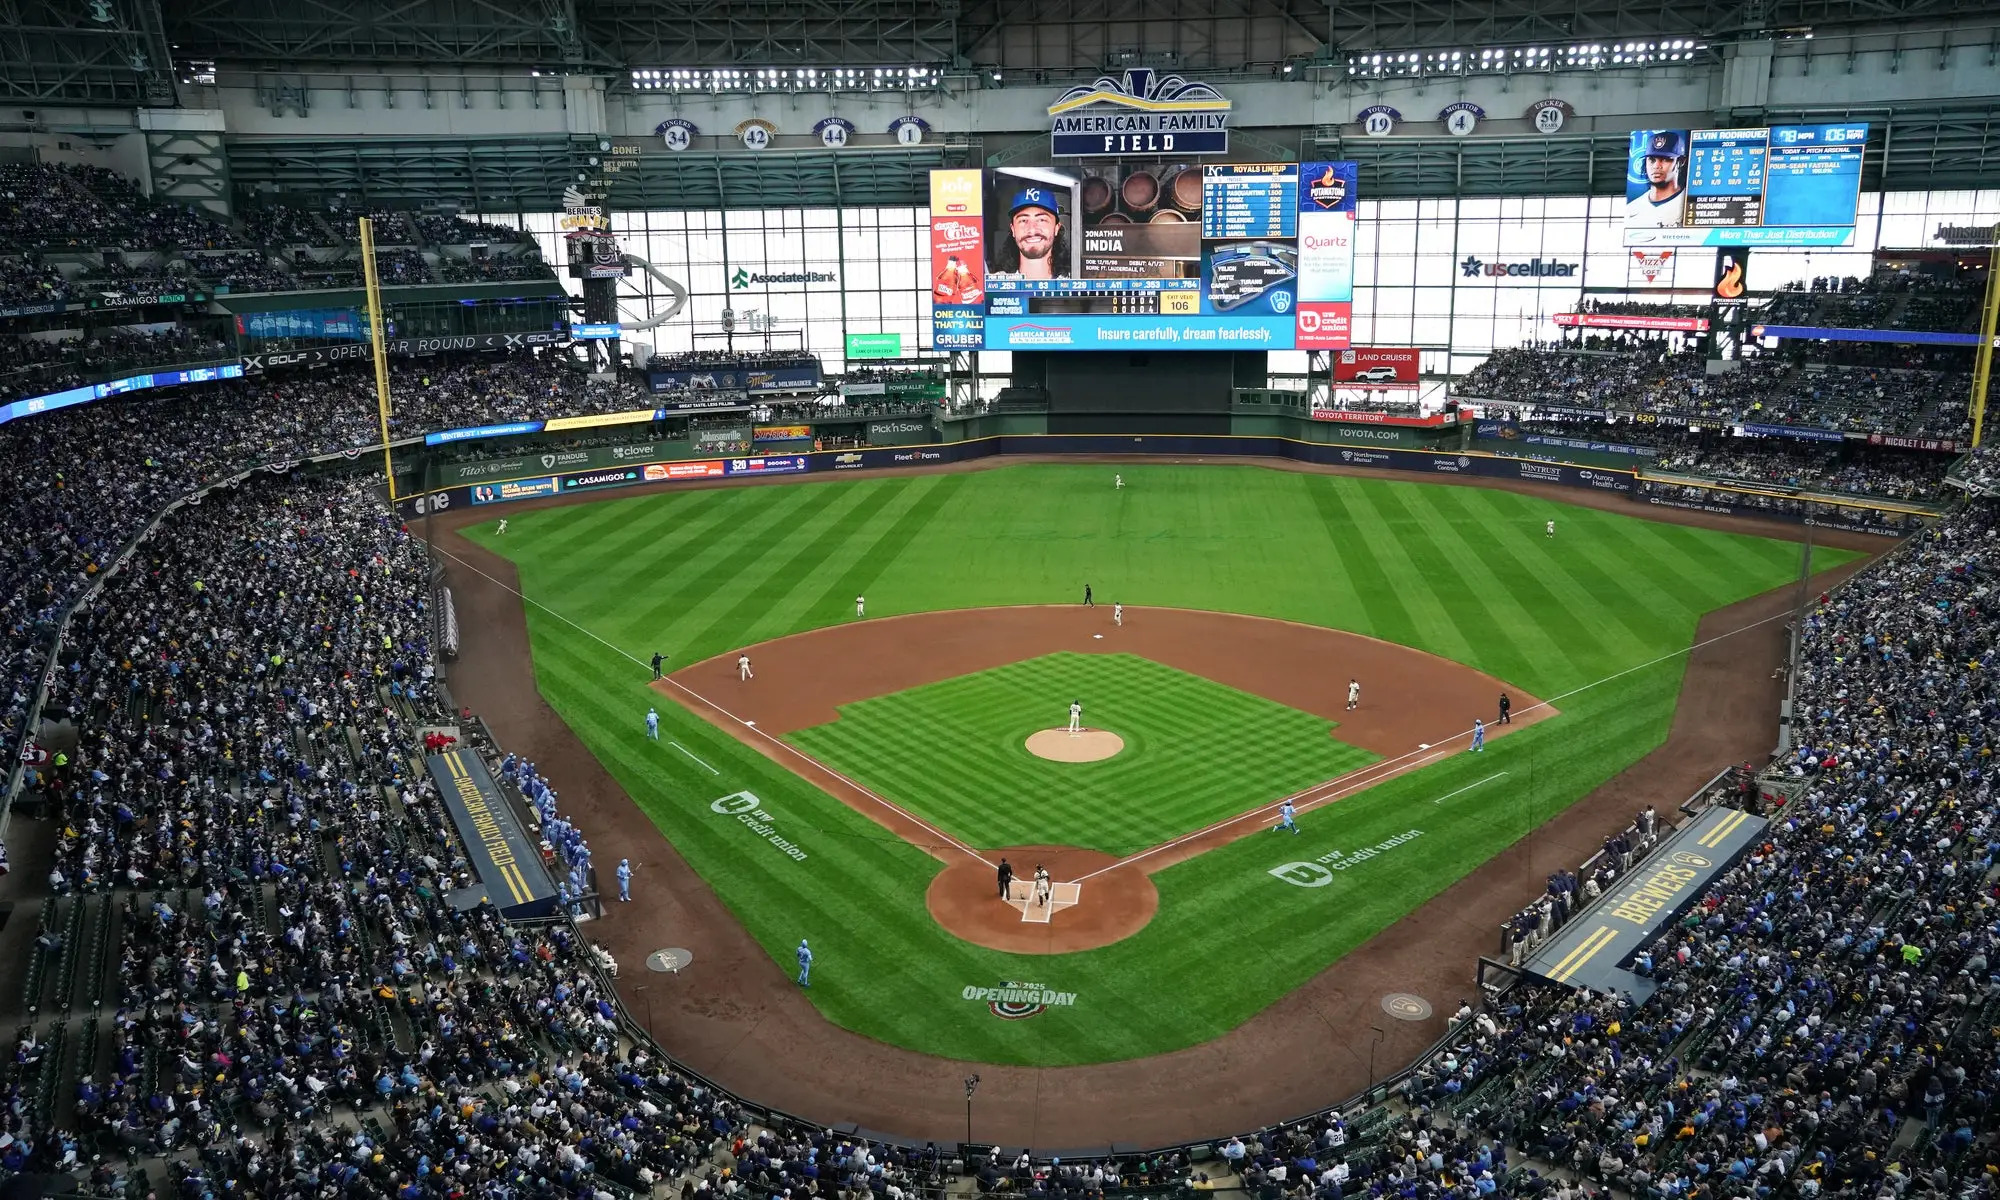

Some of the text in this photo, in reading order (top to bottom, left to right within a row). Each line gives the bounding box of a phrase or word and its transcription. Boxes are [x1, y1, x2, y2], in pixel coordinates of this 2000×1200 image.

[1367, 106, 1391, 114] YOUNT
[1445, 104, 1479, 114] MOLITOR
[1535, 99, 1564, 109] UECKER
[823, 118, 845, 126] AARON
[1455, 115, 1465, 130] 4
[1541, 110, 1558, 123] 50
[662, 118, 691, 129] FINGERS
[1054, 114, 1227, 133] AMERICAN FAMILY
[1370, 117, 1388, 132] 19
[668, 131, 687, 146] 34
[746, 131, 765, 144] 42
[825, 129, 844, 143] 44
[907, 129, 914, 142] 1
[1693, 130, 1768, 140] ELVIN RODRIGUEZ
[1797, 132, 1815, 140] MPH
[1825, 128, 1845, 141] 106
[1104, 135, 1174, 151] FIELD
[612, 146, 641, 155] GONE!
[1261, 165, 1286, 173] LINEUP
[567, 206, 601, 216] BERNIE'S
[944, 225, 980, 240] Coke
[1085, 230, 1123, 238] JONATHAN
[1720, 229, 1838, 239] More Than Just Distribution!
[1085, 240, 1123, 251] INDIA
[1304, 236, 1347, 250] Quartz
[1485, 258, 1579, 276] uscellular
[104, 296, 158, 306] CASAMIGOS
[1171, 302, 1189, 310] 106
[934, 321, 964, 329] THAT'S
[936, 334, 982, 345] GRUBER
[1097, 326, 1272, 342] Insure carefully, dream fearlessly.
[244, 355, 264, 369] X
[269, 353, 307, 366] GOLF
[330, 345, 368, 360] OPEN
[419, 337, 476, 350] ROUND
[505, 334, 523, 346] X
[527, 333, 566, 343] GOLF
[1315, 410, 1385, 421] TOYOTA TERRITORY
[1636, 413, 1687, 425] 620 WTMJ
[872, 424, 890, 433] Pick
[900, 423, 923, 432] Save
[1339, 428, 1399, 440] TOYOTA.COM
[1744, 424, 1842, 440] WINTRUST WISCONSIN'S BANK
[441, 430, 475, 440] WINTRUST
[700, 430, 741, 442] Johnsonville
[1543, 438, 1562, 446] WELCOME
[1608, 445, 1629, 453] WELCOME
[1884, 437, 1918, 448] NICOLET
[1920, 440, 1938, 450] LAW
[624, 446, 654, 455] clover
[1353, 452, 1389, 460] Northwestern
[557, 453, 588, 465] FANDUEL
[460, 466, 486, 477] Tito's
[732, 460, 746, 471] $20
[1520, 463, 1561, 475] WINTRUST
[579, 473, 625, 485] CASAMIGOS
[1593, 473, 1614, 482] Aurora
[1592, 480, 1629, 491] Health Care
[1704, 505, 1731, 514] BULLPEN
[1815, 520, 1832, 528] Aurora
[1868, 527, 1898, 537] BULLPEN
[453, 776, 489, 817] AMERICAN
[752, 809, 775, 821] uw
[471, 812, 503, 844] FAMILY
[737, 814, 807, 861] credit union
[486, 840, 515, 866] FIELD
[1332, 829, 1424, 871] credit union
[1316, 850, 1344, 864] uw
[1611, 864, 1697, 925] BREWERS
[1023, 982, 1045, 990] 2025
[962, 985, 1077, 1006] OPENING DAY
